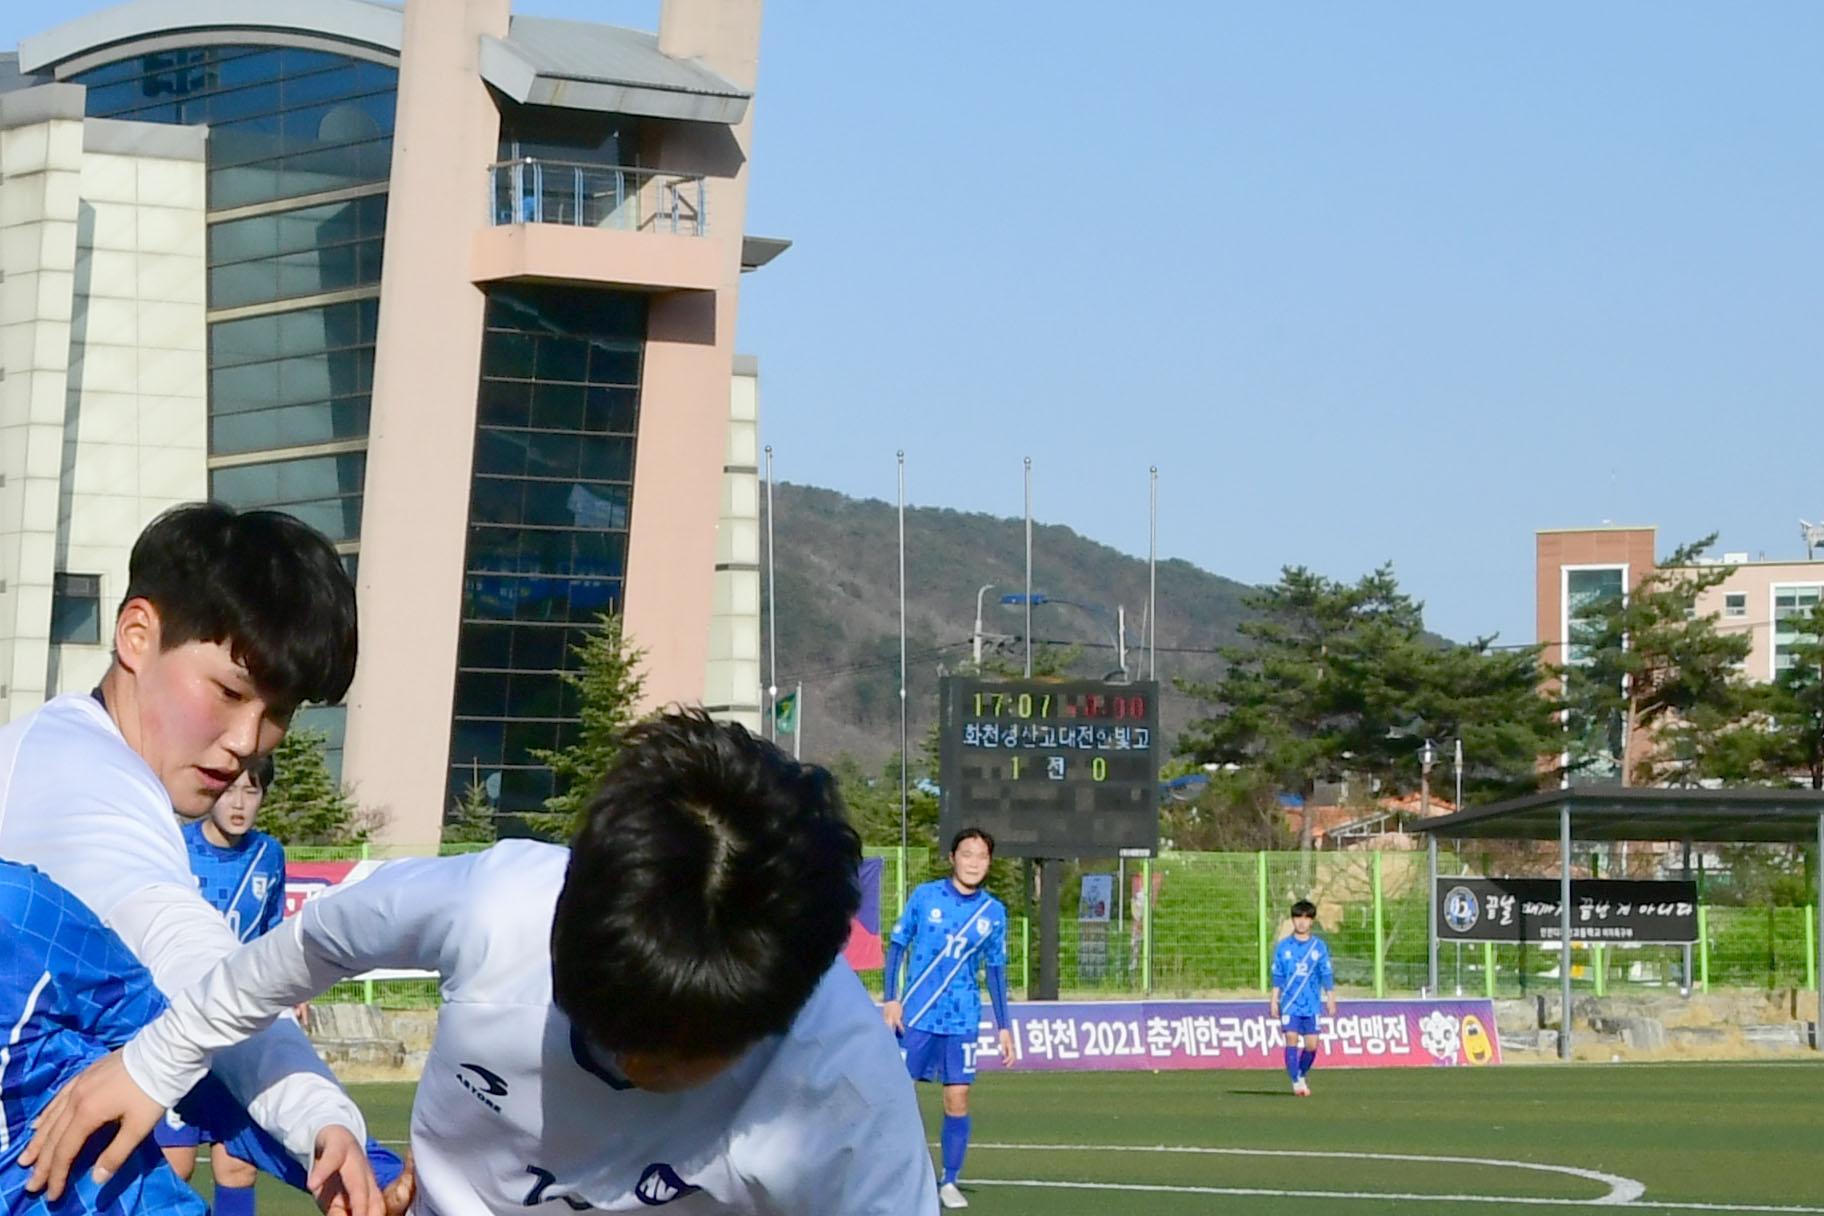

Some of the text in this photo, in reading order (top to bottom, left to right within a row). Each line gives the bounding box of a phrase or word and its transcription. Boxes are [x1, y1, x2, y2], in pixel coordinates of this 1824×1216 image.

[973, 693, 1051, 718] 17:07
[1011, 755, 1019, 780] 1
[1092, 757, 1106, 781] 0
[1638, 901, 1693, 916] 아니다
[945, 933, 968, 960] 17
[1025, 1018, 1080, 1059] 화천
[1081, 1020, 1144, 1056] 2021
